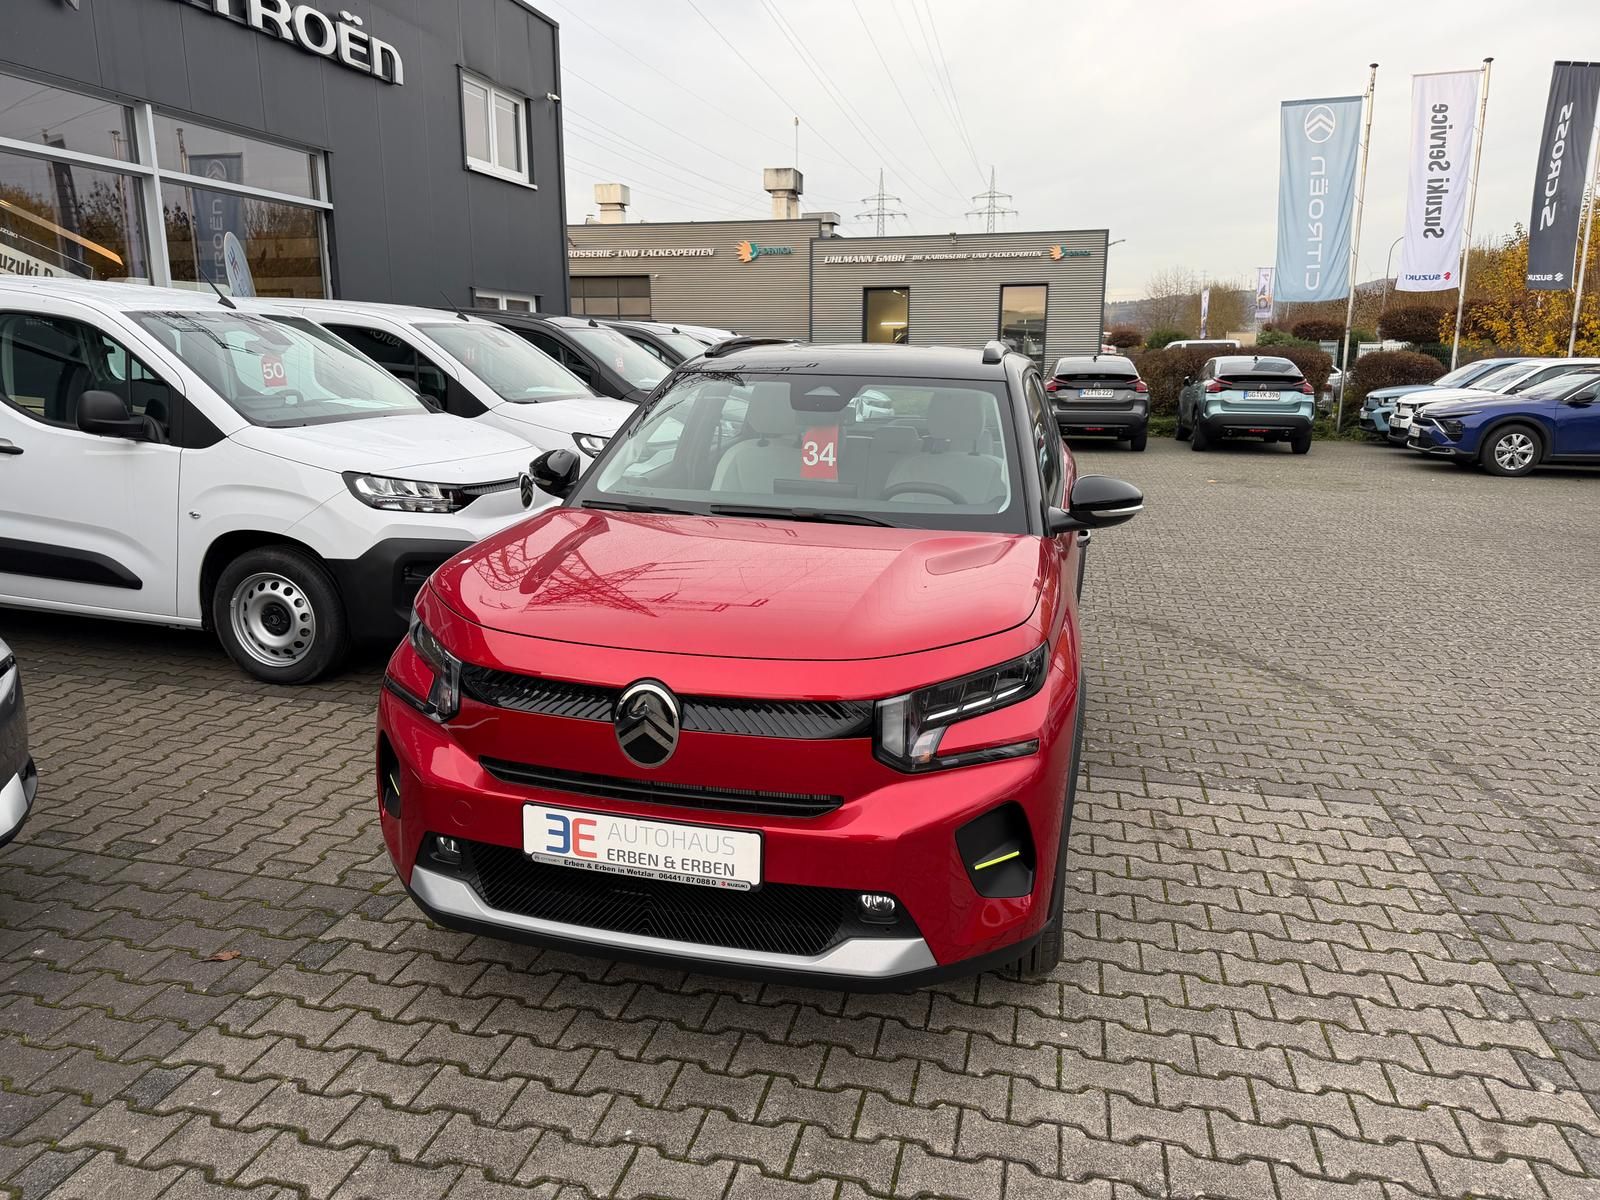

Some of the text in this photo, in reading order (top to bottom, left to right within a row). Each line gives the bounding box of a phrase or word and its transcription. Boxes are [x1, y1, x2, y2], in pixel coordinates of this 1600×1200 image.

[200, 0, 404, 85] ROËn
[0, 253, 39, 276] uzuki
[568, 248, 714, 258] ROSSERIE- UND LACKEXPERTEN
[824, 255, 874, 264] UHLMANN
[263, 362, 285, 379] 50
[803, 441, 837, 467] 34
[607, 823, 735, 856] AUTOHAUS
[564, 859, 585, 868] Erben
[594, 863, 616, 873] Erben
[618, 866, 625, 874] in
[626, 868, 655, 878] Wetzlar
[607, 848, 735, 877] ERBEN & ERBEN
